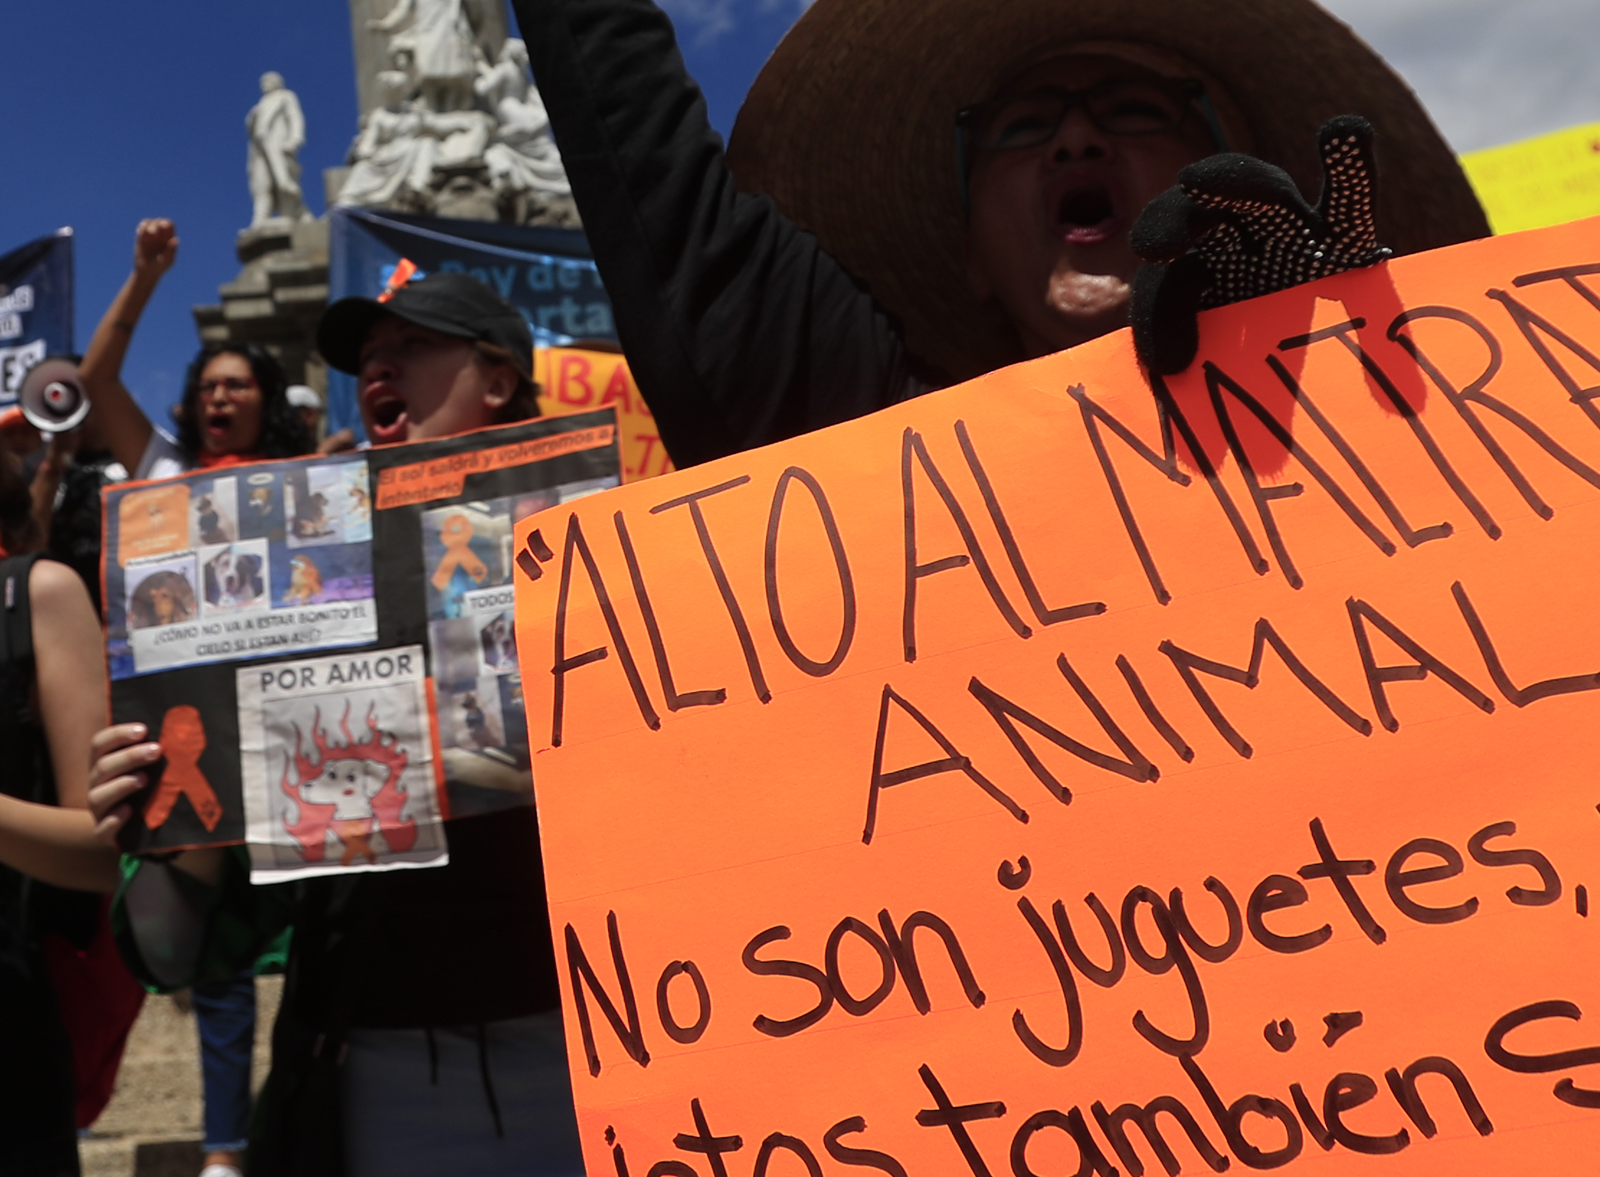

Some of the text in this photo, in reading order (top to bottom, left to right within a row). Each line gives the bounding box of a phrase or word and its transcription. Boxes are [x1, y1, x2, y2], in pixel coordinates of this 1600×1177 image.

[497, 431, 595, 462] volveremos
[903, 419, 1107, 663] AL
[202, 624, 221, 636] NO
[257, 614, 296, 628] ESTAR
[260, 654, 414, 694] POR AMOR
[862, 580, 1600, 845] ANIMAL
[563, 909, 712, 1079] No
[741, 908, 987, 1038] son
